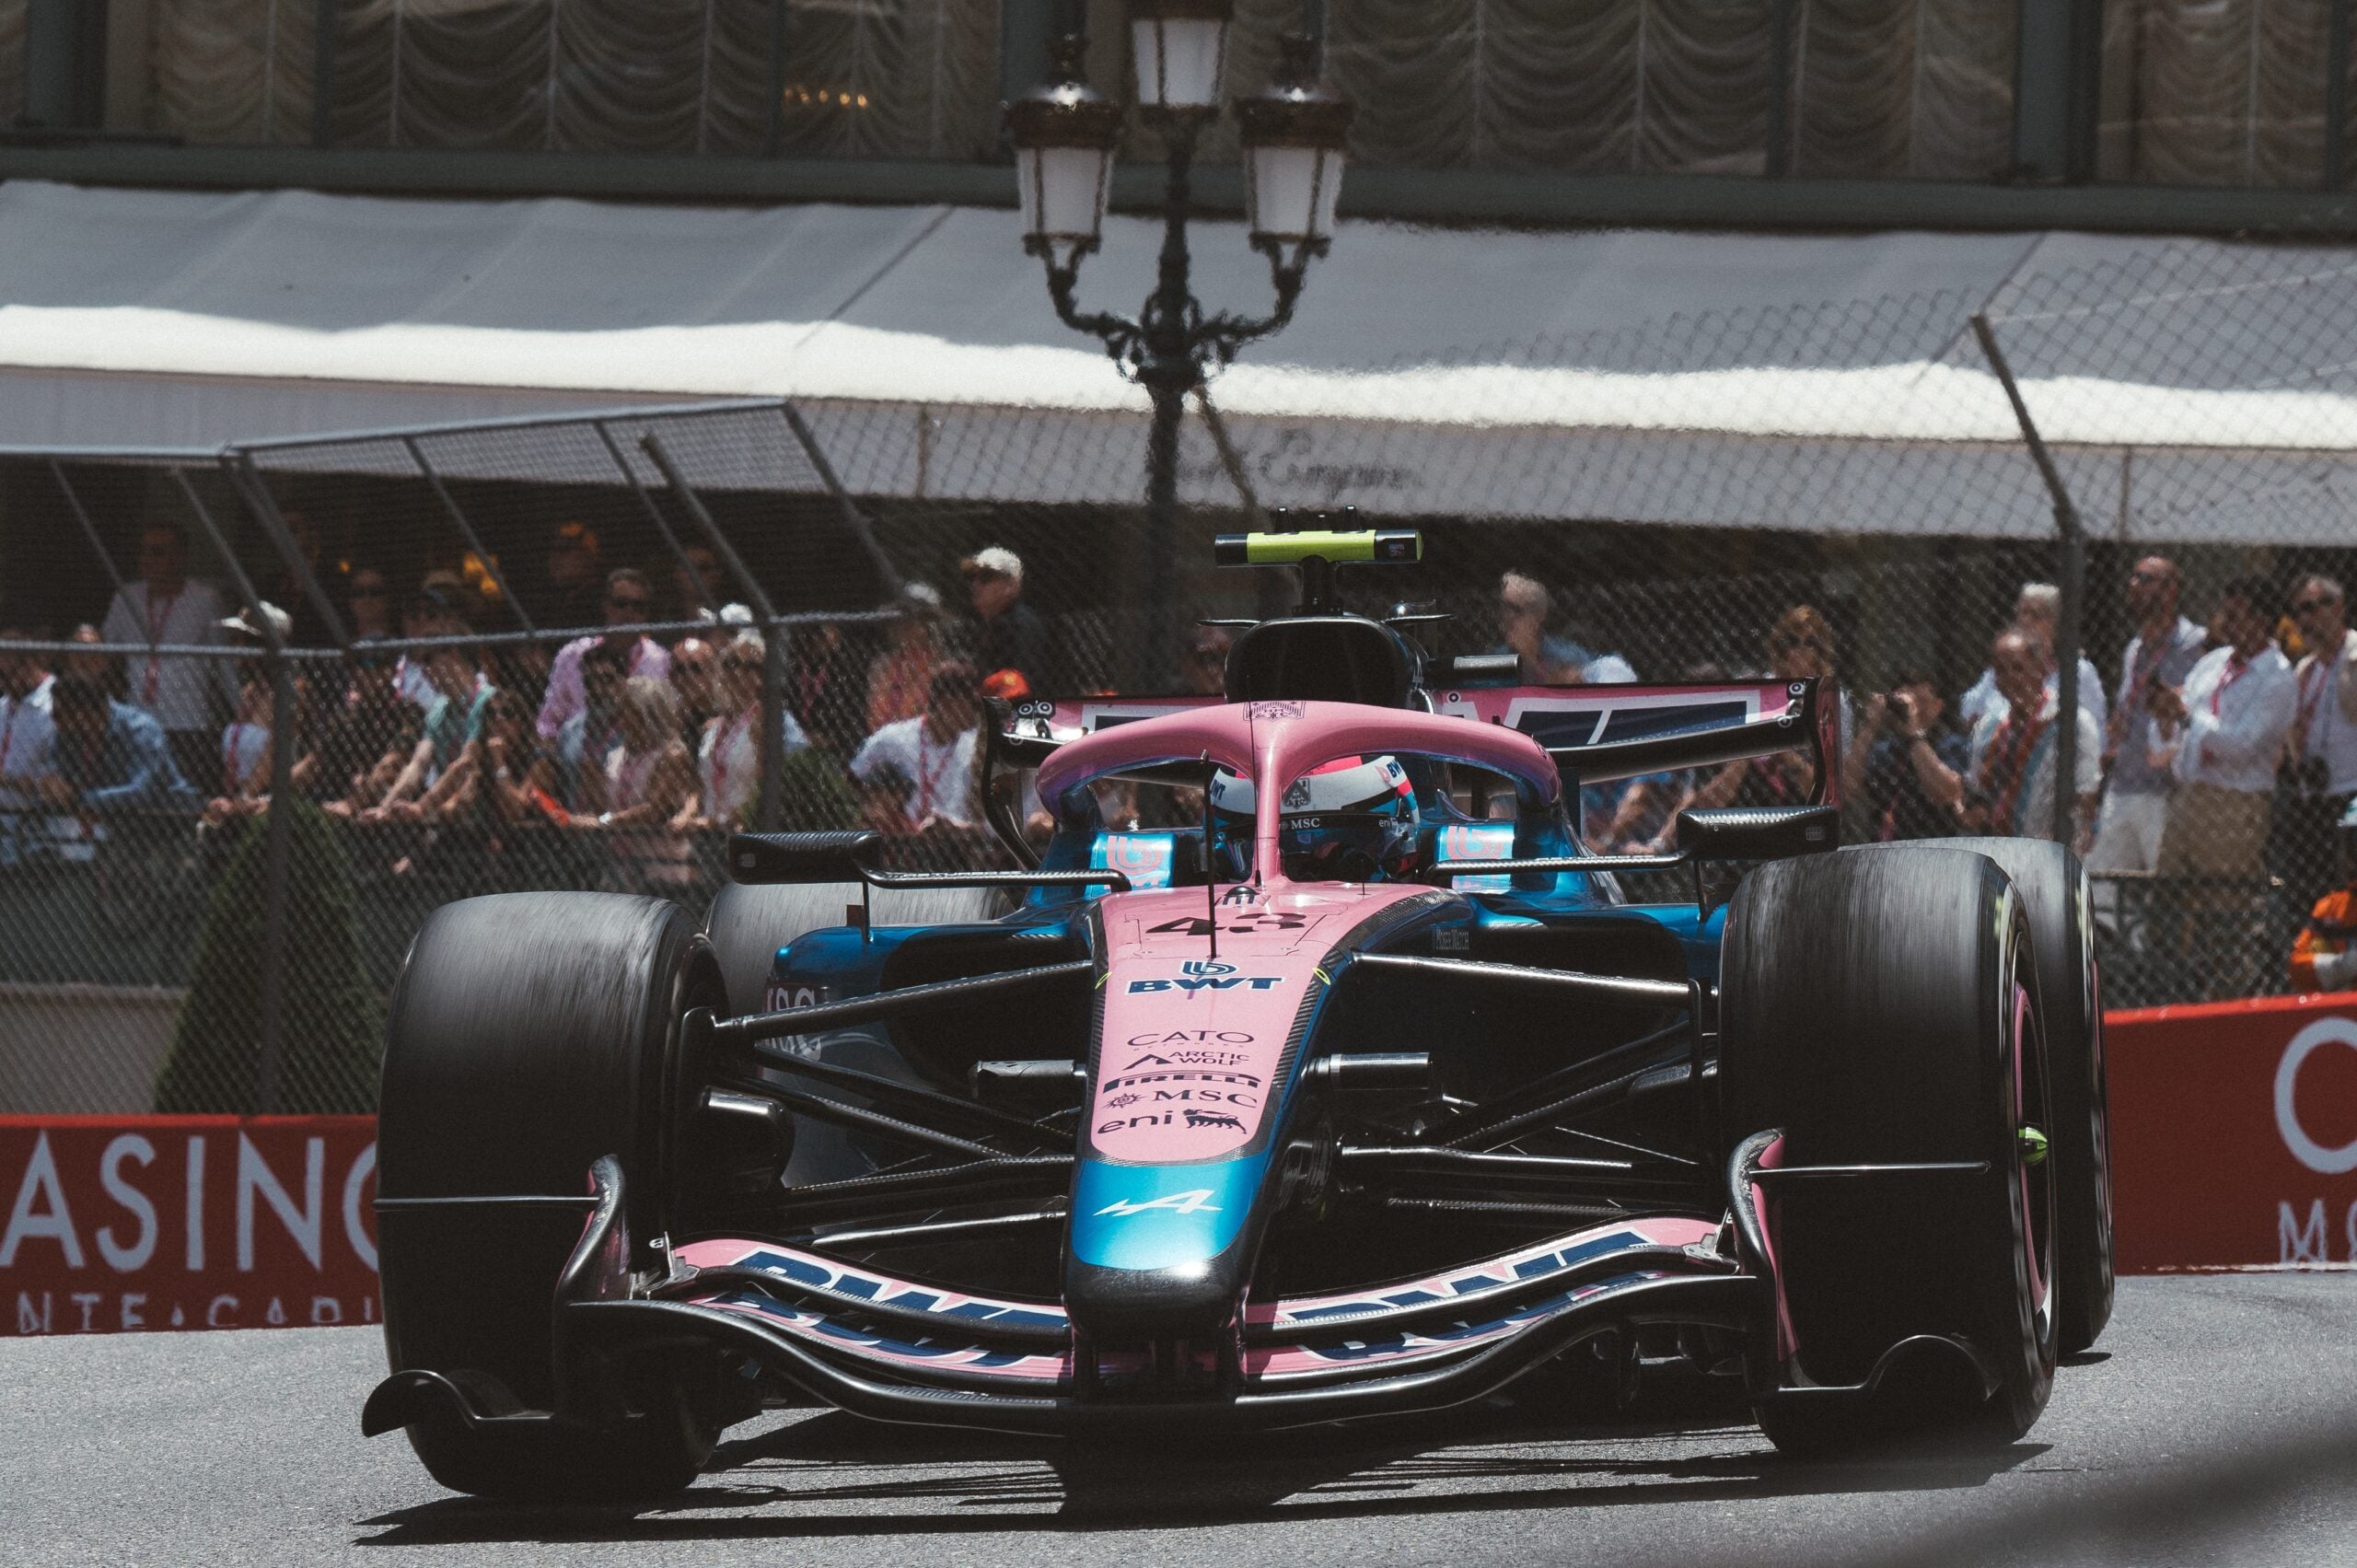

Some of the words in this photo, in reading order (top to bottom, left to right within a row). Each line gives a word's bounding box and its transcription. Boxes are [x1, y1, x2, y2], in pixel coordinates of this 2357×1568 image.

[1291, 818, 1320, 830] MSC
[1378, 818, 1390, 829] eni
[1145, 912, 1306, 936] 43
[1127, 977, 1283, 994] BWT
[1128, 1029, 1255, 1047] CATO
[1169, 1051, 1250, 1062] ARCTIC
[1179, 1058, 1242, 1066] WOLF
[1103, 1070, 1262, 1094] PIRELLI
[1153, 1089, 1258, 1109] MSC
[1097, 1110, 1174, 1134] eni
